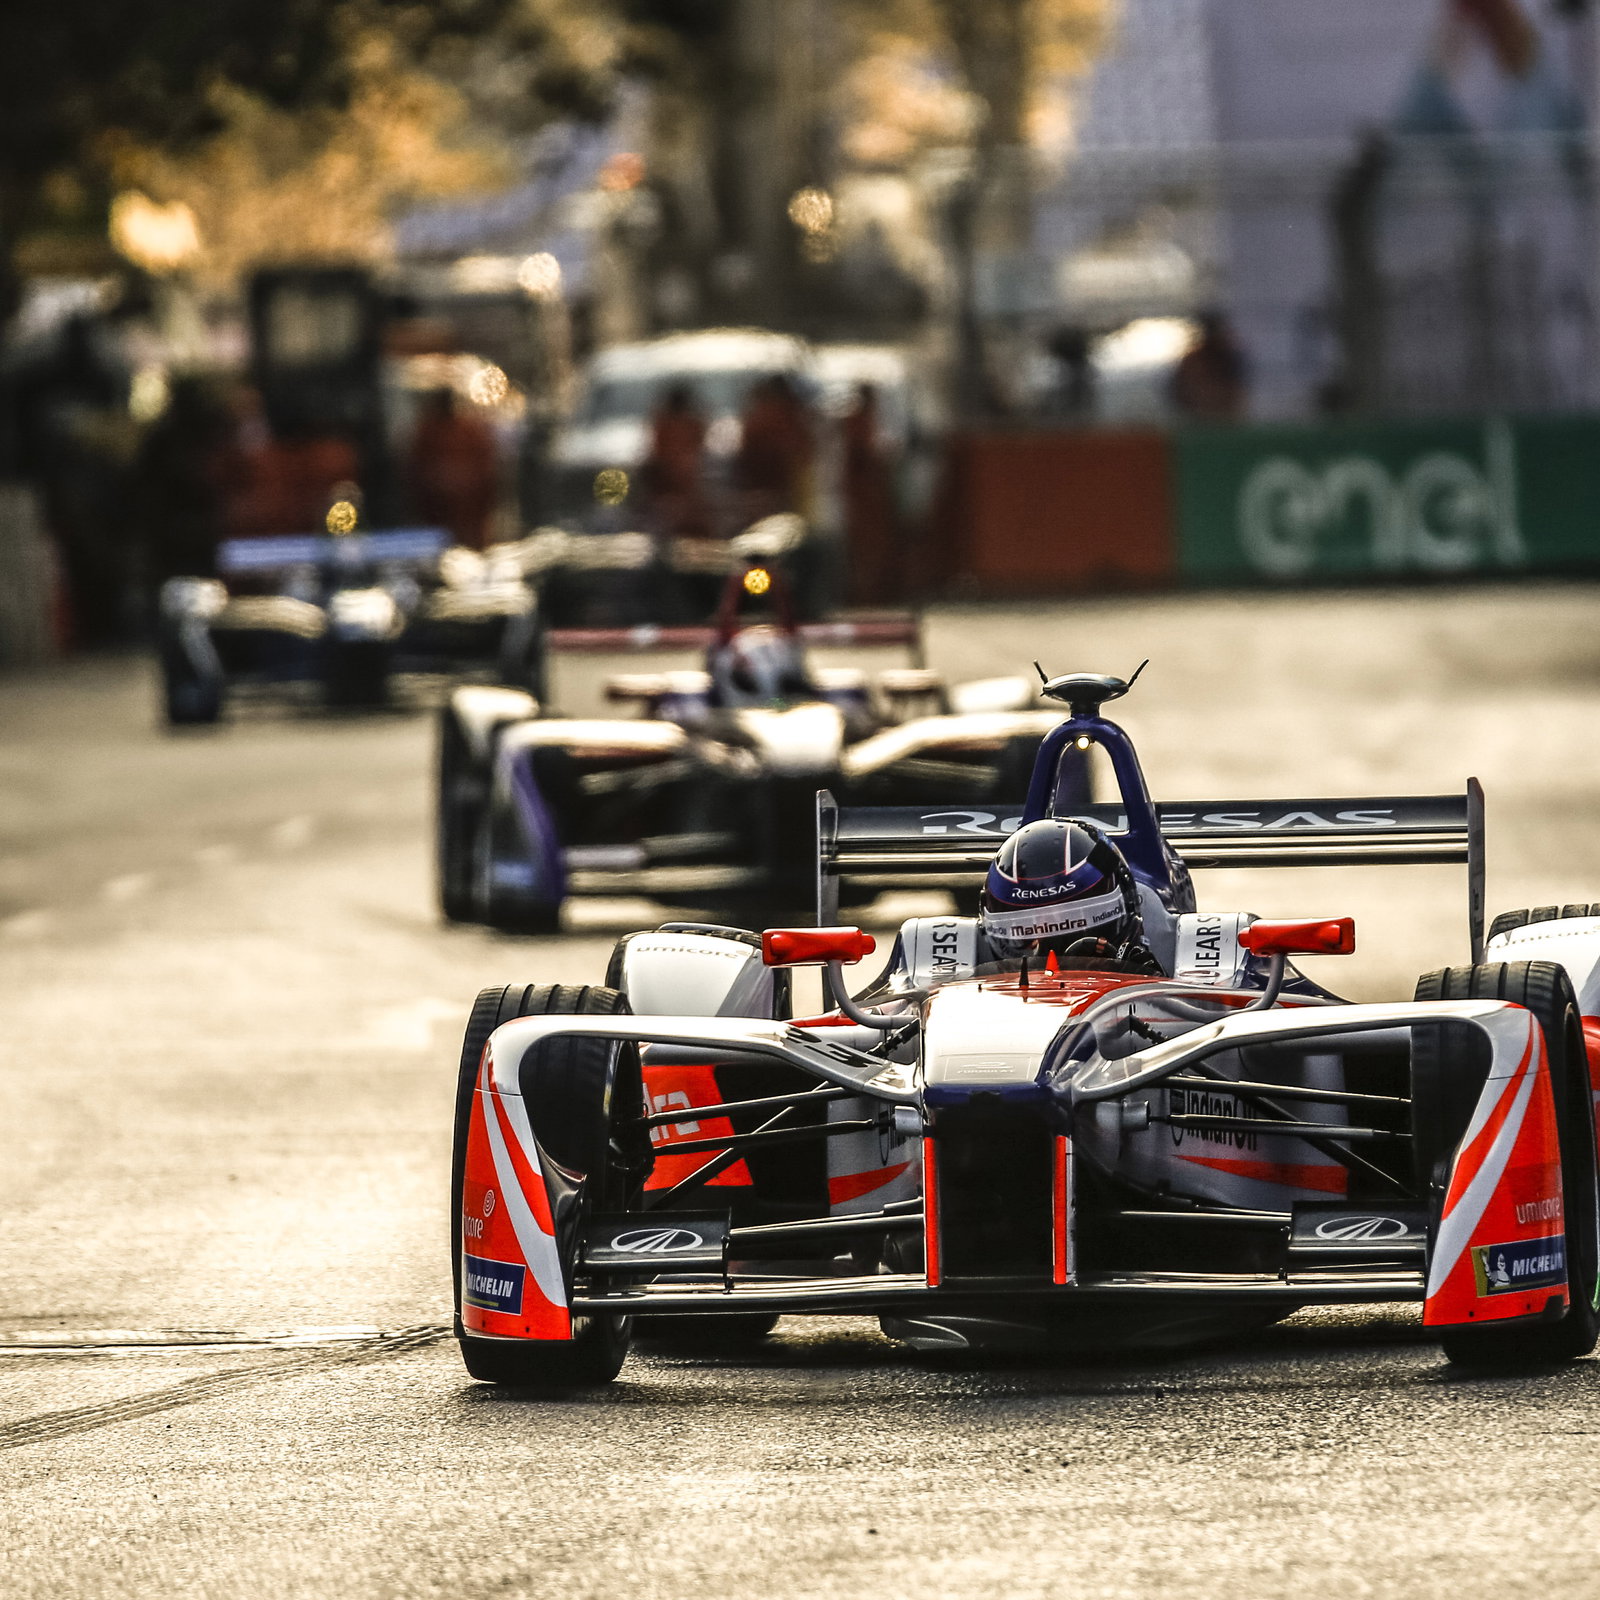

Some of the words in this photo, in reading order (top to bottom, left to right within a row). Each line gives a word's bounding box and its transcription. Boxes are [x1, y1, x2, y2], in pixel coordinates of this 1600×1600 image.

[1238, 418, 1525, 577] enel
[1011, 880, 1077, 899] RENESAS
[1011, 918, 1088, 937] Mahindra
[1194, 925, 1221, 968] LEAR
[1515, 1193, 1561, 1224] umicore
[1512, 1252, 1564, 1277] MICHELIN
[466, 1272, 514, 1298] MICHELIN
